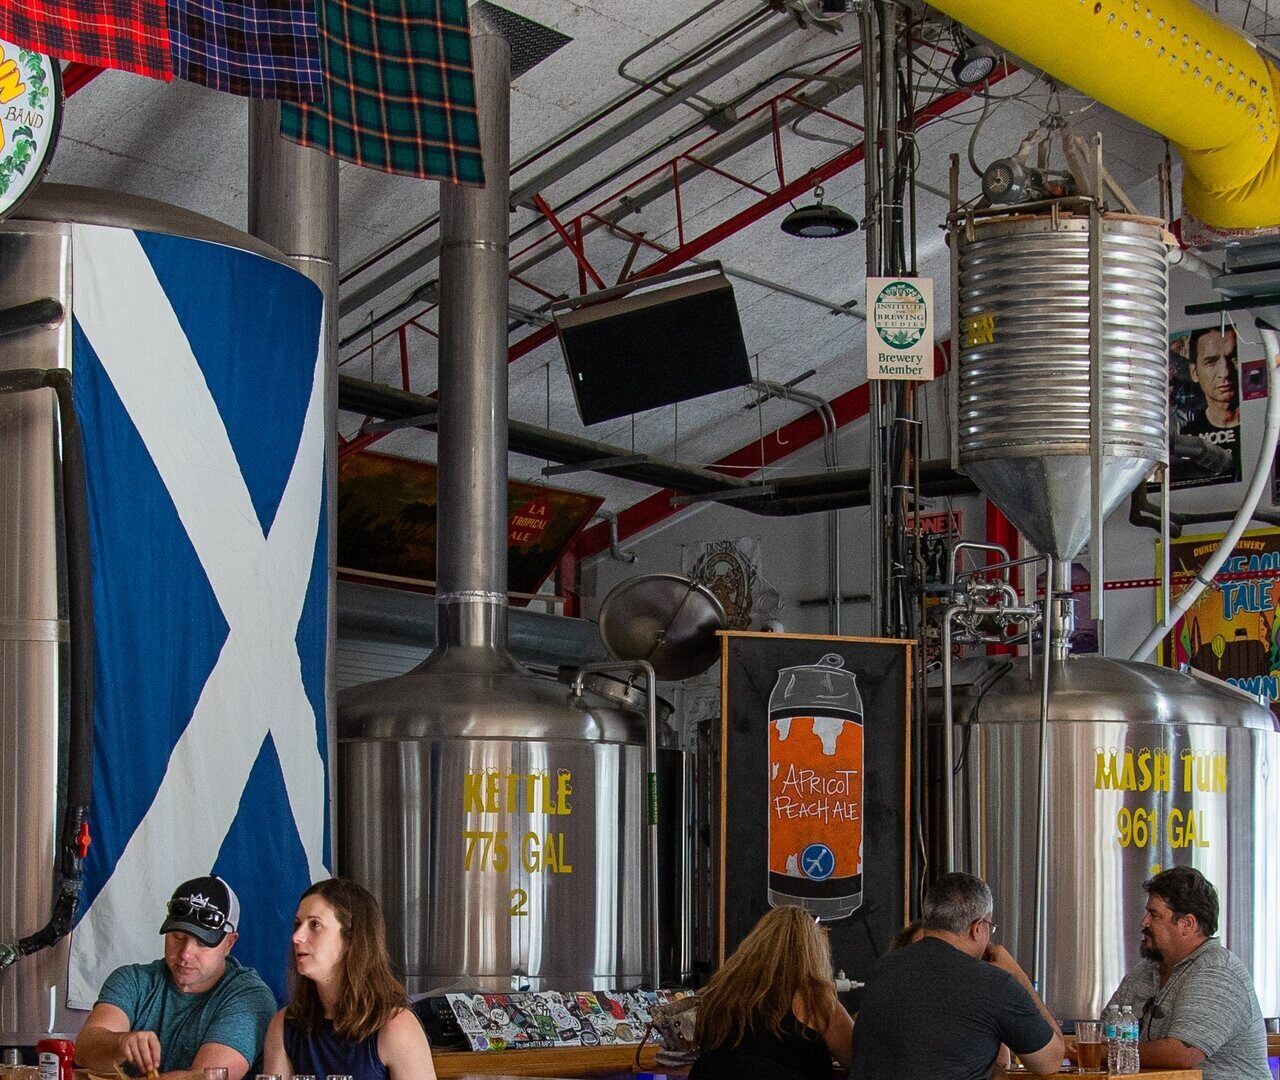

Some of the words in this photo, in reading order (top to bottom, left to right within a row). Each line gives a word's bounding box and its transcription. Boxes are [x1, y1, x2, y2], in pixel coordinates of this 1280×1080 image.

[5, 106, 44, 129] BAND
[878, 353, 923, 365] Brewery
[878, 365, 923, 375] Member
[1199, 430, 1235, 444] MODE
[528, 504, 545, 515] LA
[511, 515, 548, 530] TROPICAL
[509, 531, 529, 541] ALE
[1193, 541, 1223, 557] DUNED
[1236, 540, 1265, 551] REWERY
[1220, 583, 1274, 621] TALE
[782, 763, 857, 798] APRICOT
[1095, 748, 1171, 792] MASH
[1180, 748, 1227, 793] TUN
[463, 769, 572, 815] KETTLE
[773, 796, 829, 824] PEACH
[833, 801, 859, 822] ALE
[1117, 807, 1157, 848] 961
[1167, 808, 1209, 848] GAL
[462, 832, 509, 874] 775
[522, 832, 573, 874] GAL
[509, 888, 528, 916] 2
